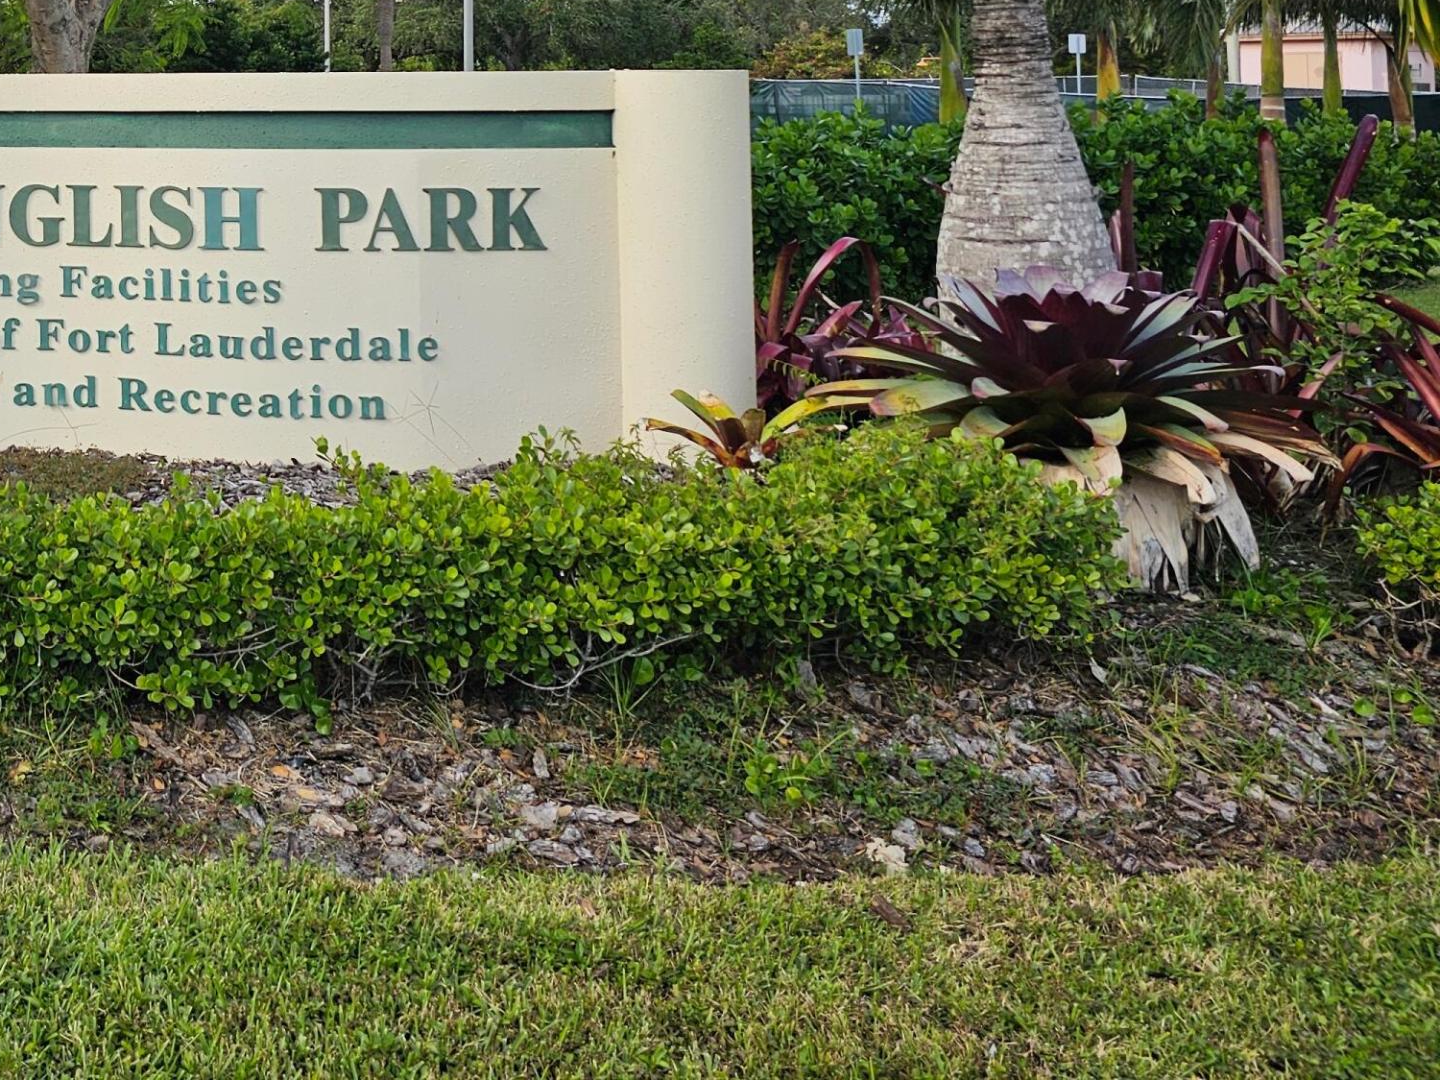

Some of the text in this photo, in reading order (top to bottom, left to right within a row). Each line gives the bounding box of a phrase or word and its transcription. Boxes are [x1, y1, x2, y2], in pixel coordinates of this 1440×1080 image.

[315, 186, 548, 252] PARK
[61, 265, 282, 305] Facilities
[36, 319, 134, 355] Fort
[154, 322, 439, 362] Lauderdale
[13, 375, 98, 409] and
[117, 377, 387, 421] Recreation
